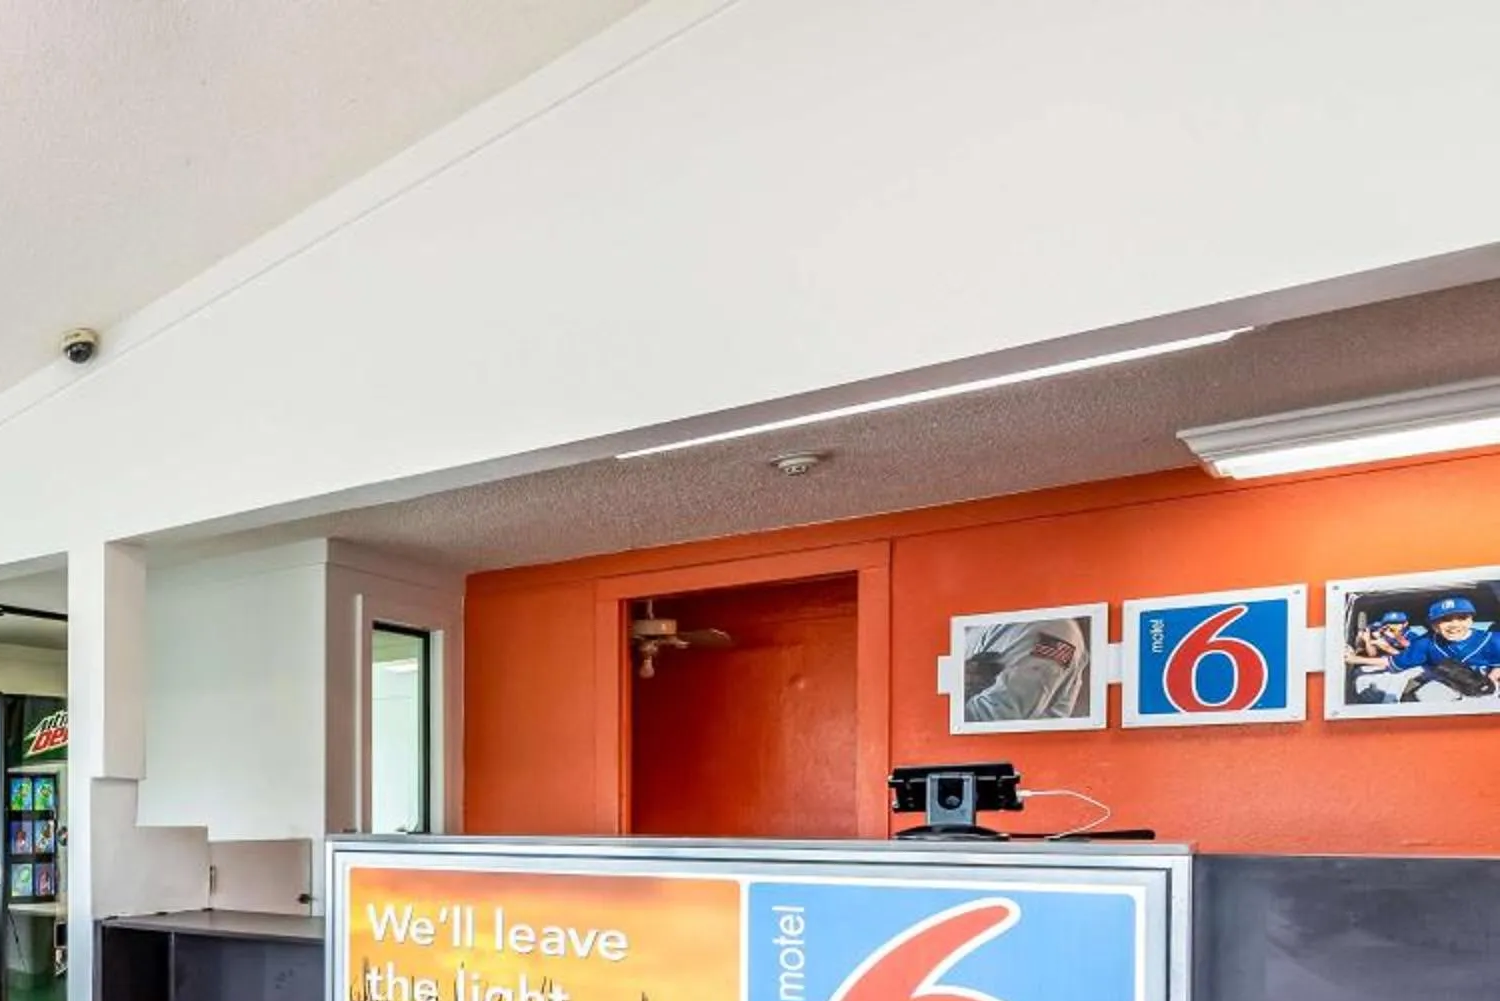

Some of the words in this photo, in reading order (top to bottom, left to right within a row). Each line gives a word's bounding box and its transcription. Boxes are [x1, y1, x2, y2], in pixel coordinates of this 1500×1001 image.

[1162, 605, 1269, 713] 6
[367, 903, 475, 947] We'll
[494, 906, 629, 962] leave
[771, 905, 805, 1001] motel
